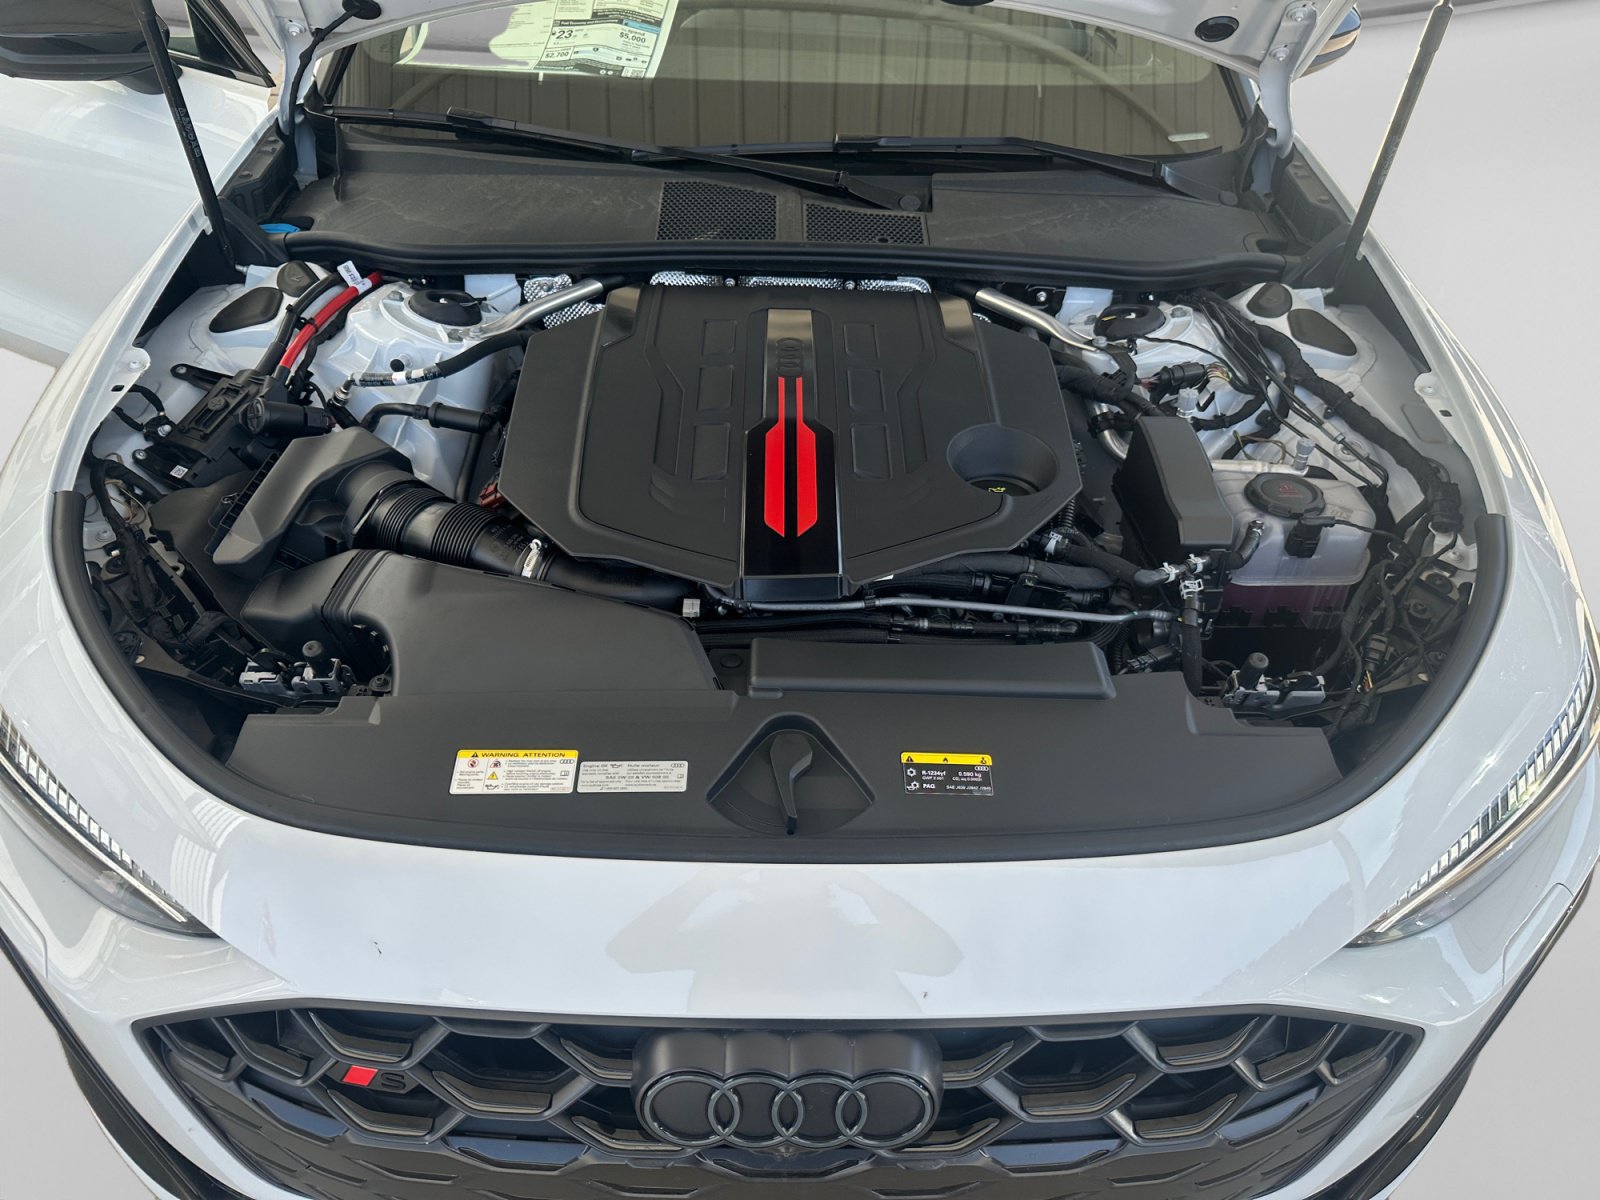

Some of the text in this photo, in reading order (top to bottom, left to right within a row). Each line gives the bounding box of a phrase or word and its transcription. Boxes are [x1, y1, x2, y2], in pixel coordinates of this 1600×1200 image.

[556, 30, 574, 39] 23
[619, 32, 646, 43] $5,000
[381, 1072, 406, 1090] S
